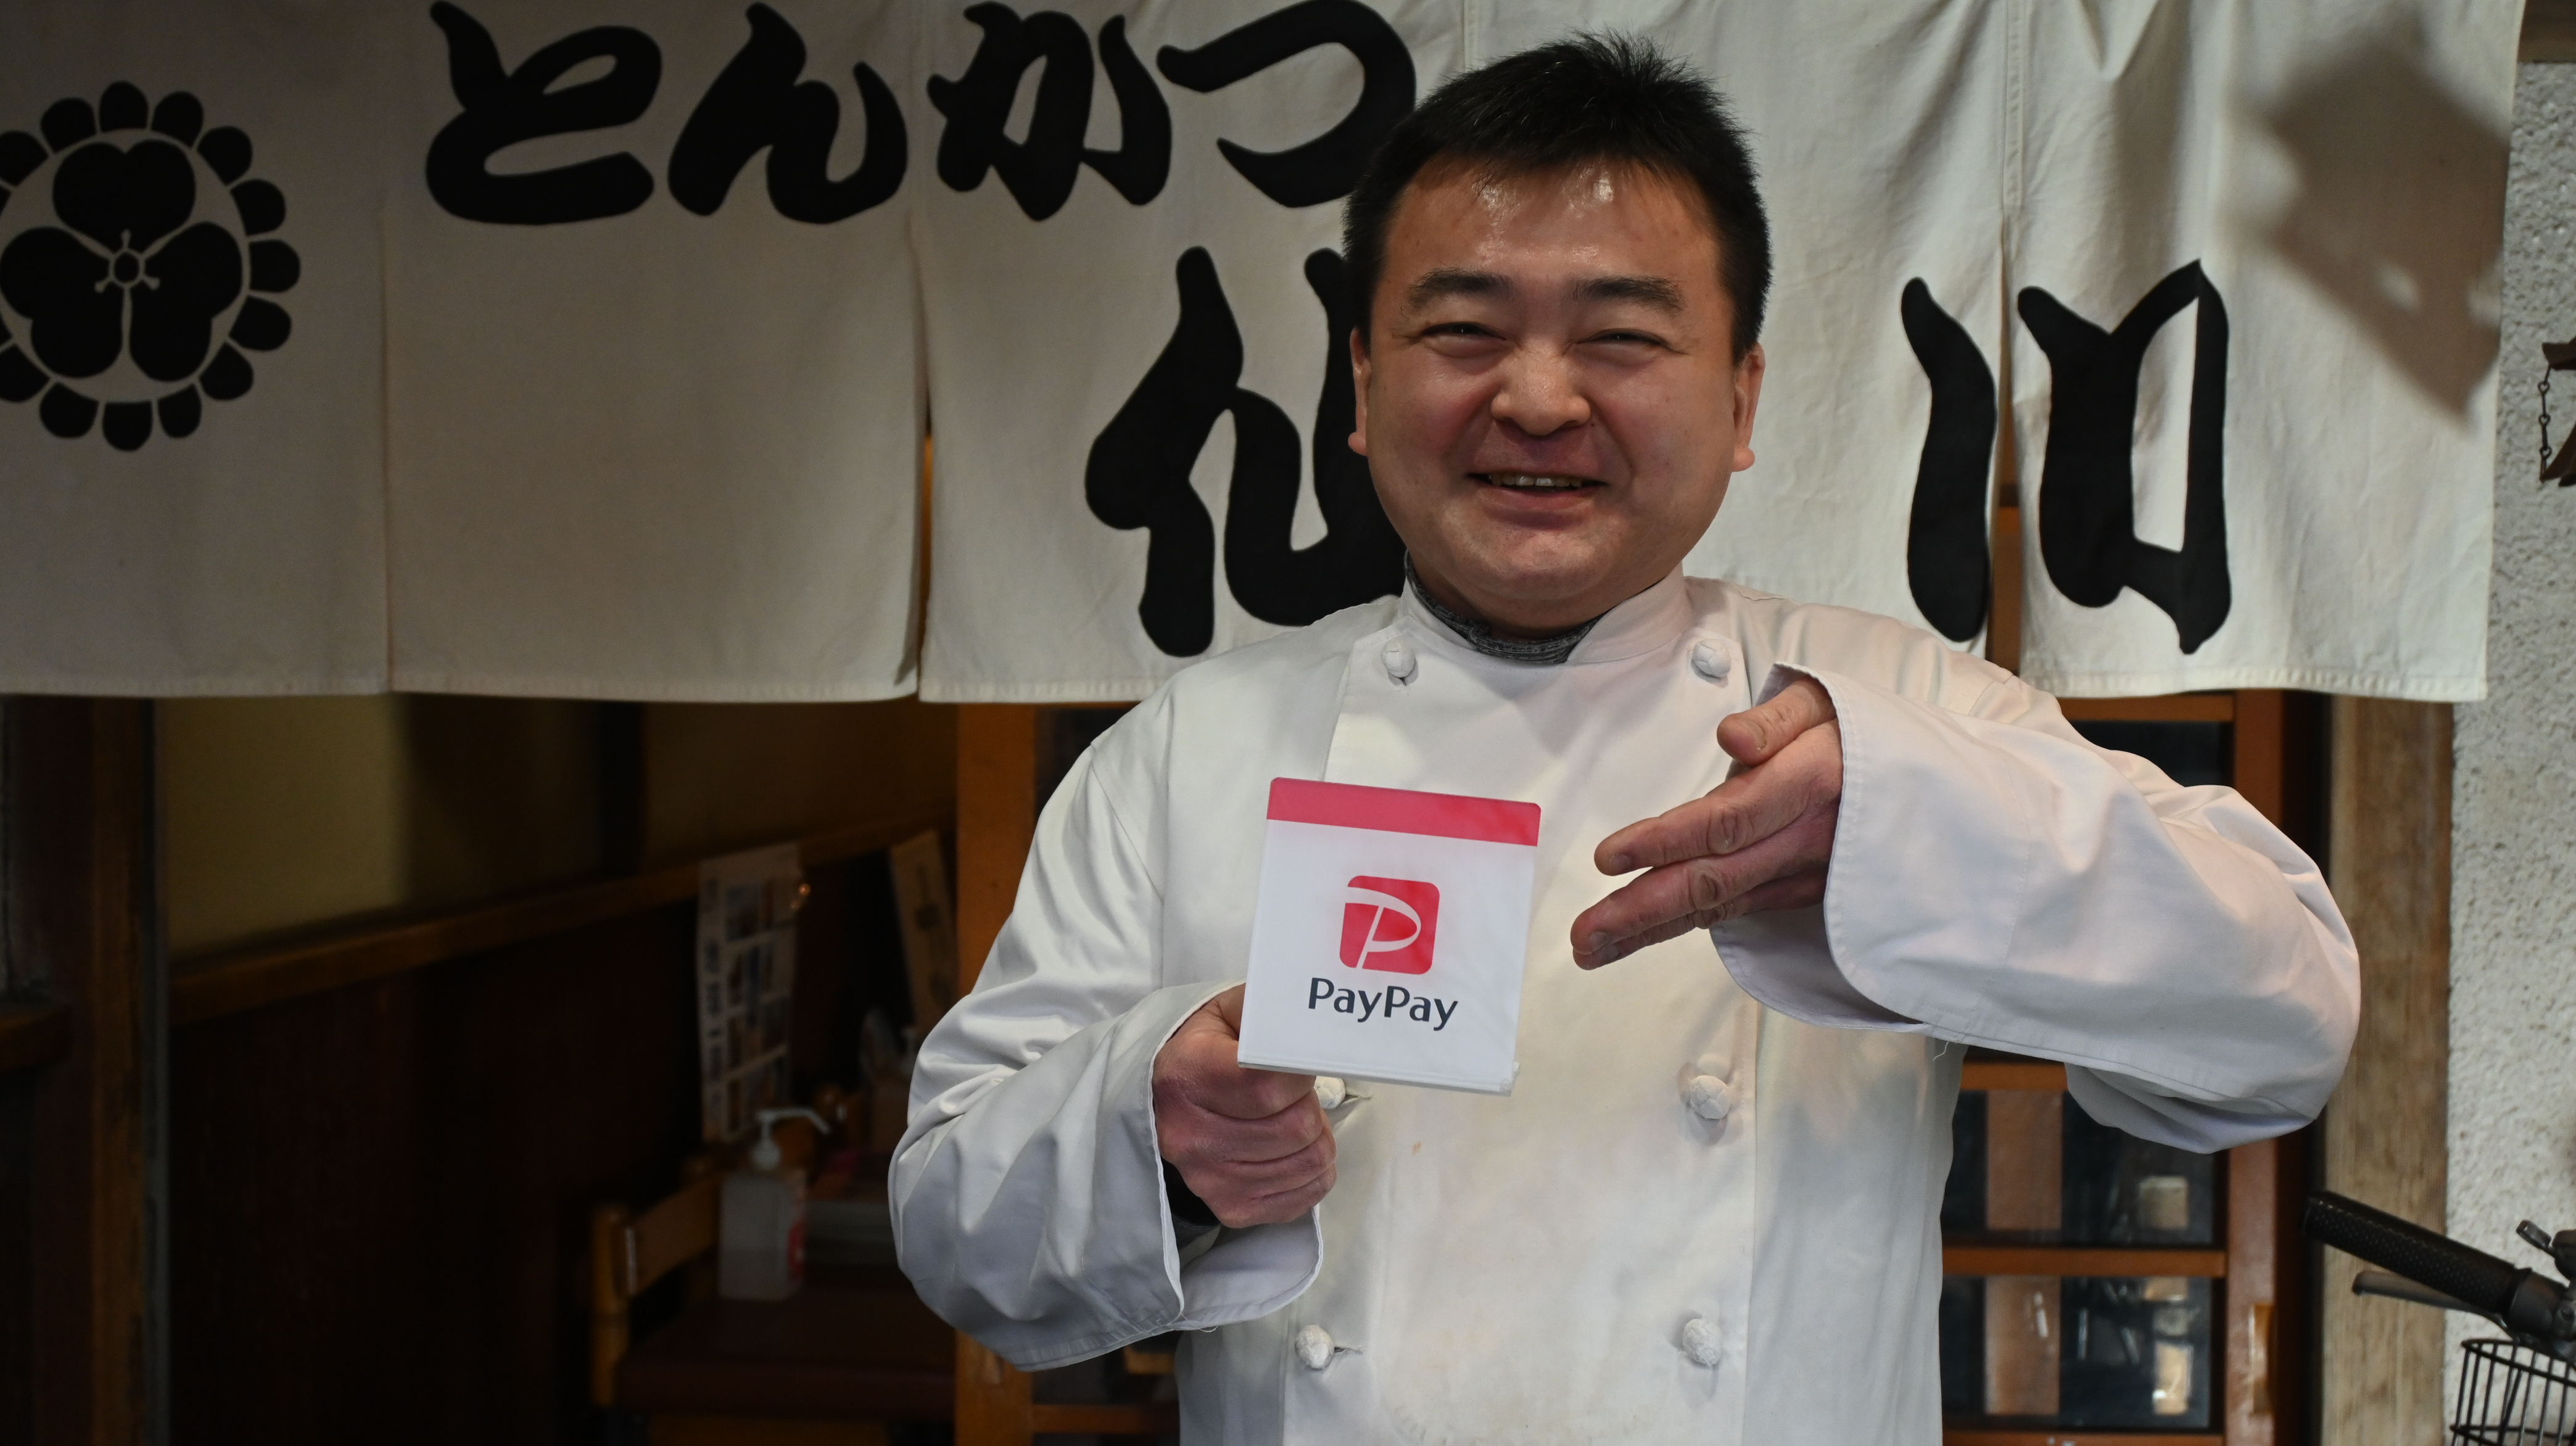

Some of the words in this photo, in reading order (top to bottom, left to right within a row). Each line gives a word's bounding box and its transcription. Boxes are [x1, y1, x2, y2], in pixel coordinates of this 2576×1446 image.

[426, 0, 1416, 225] とんかつ
[1308, 977, 1458, 1031] PayPay
